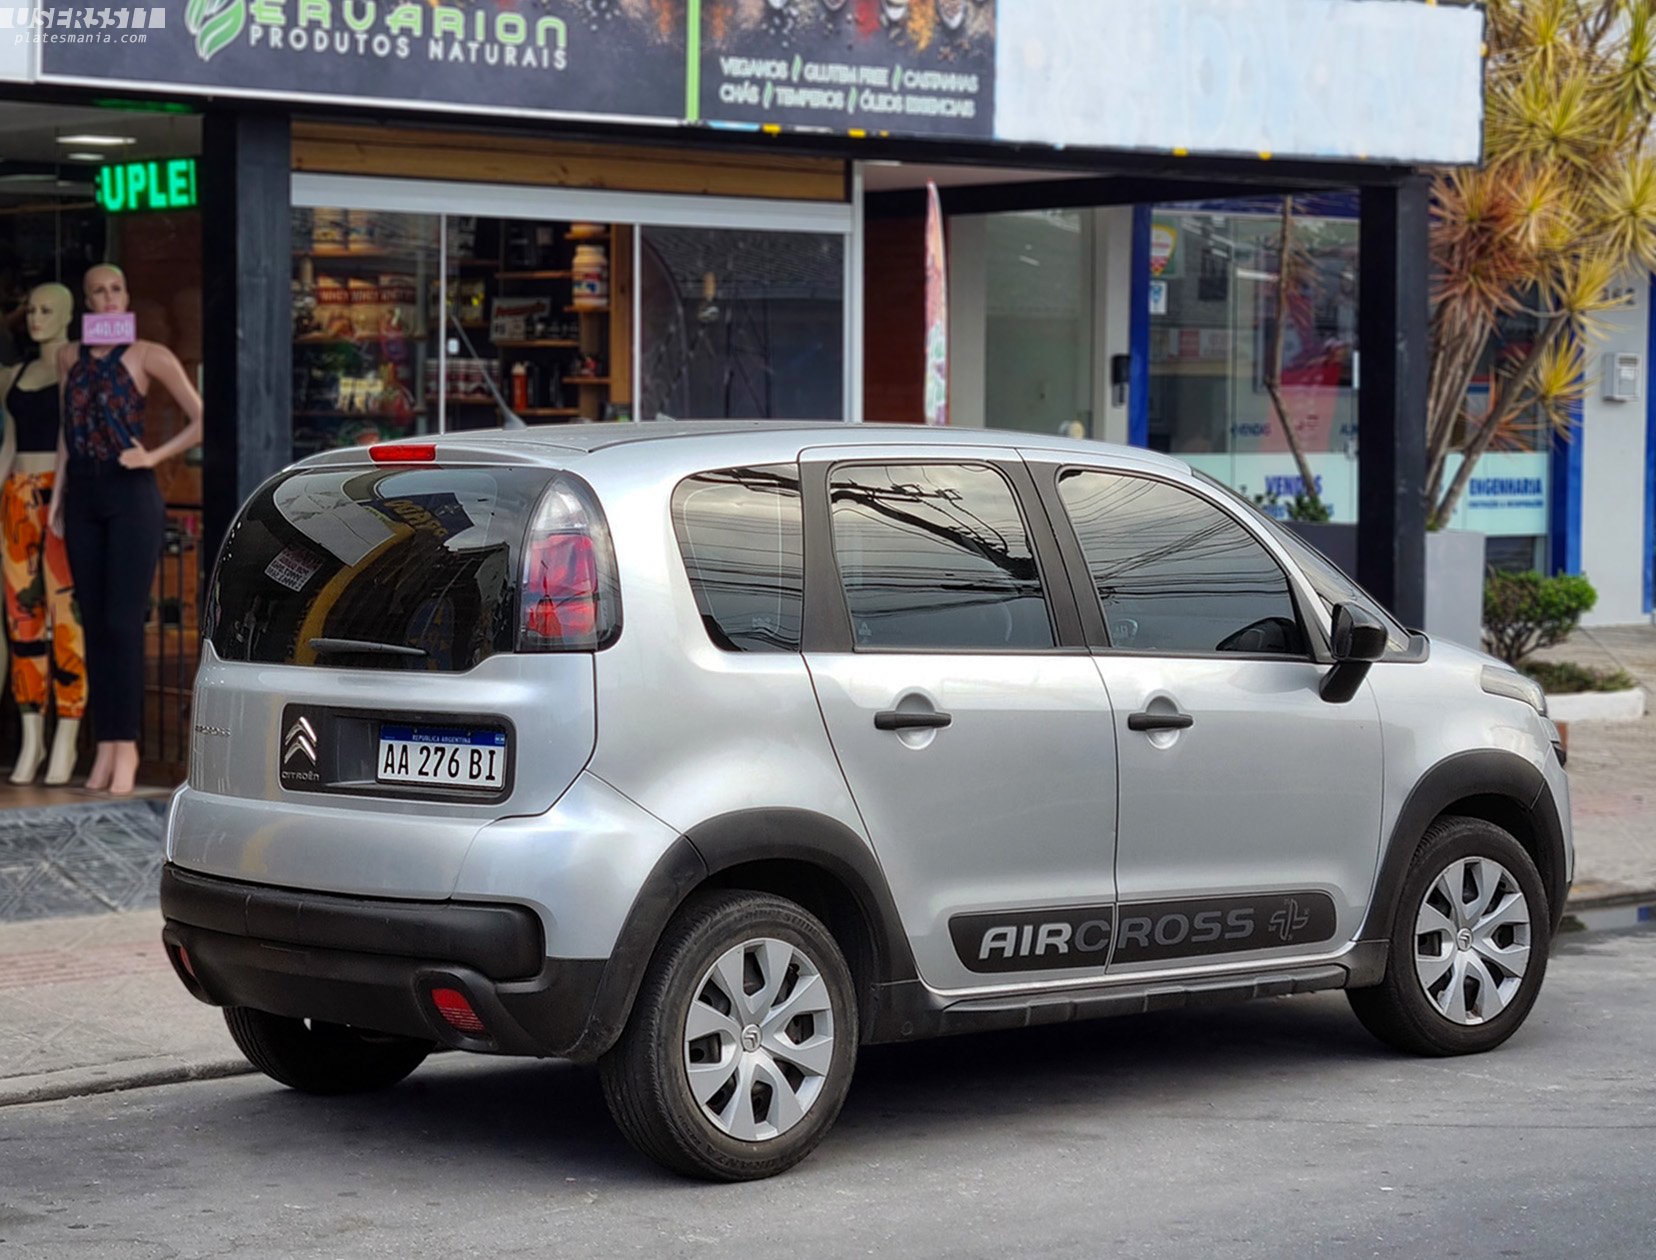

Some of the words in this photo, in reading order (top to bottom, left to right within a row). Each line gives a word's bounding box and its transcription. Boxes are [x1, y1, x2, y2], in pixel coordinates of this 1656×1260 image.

[250, 24, 411, 58] PRODUTOS
[428, 38, 567, 70] NATURAIS
[1468, 477, 1542, 496] ENGENHARIA
[383, 743, 409, 775] AA
[418, 745, 460, 778] 276
[468, 748, 496, 781] BI
[977, 906, 1256, 961] AIRCROSS
